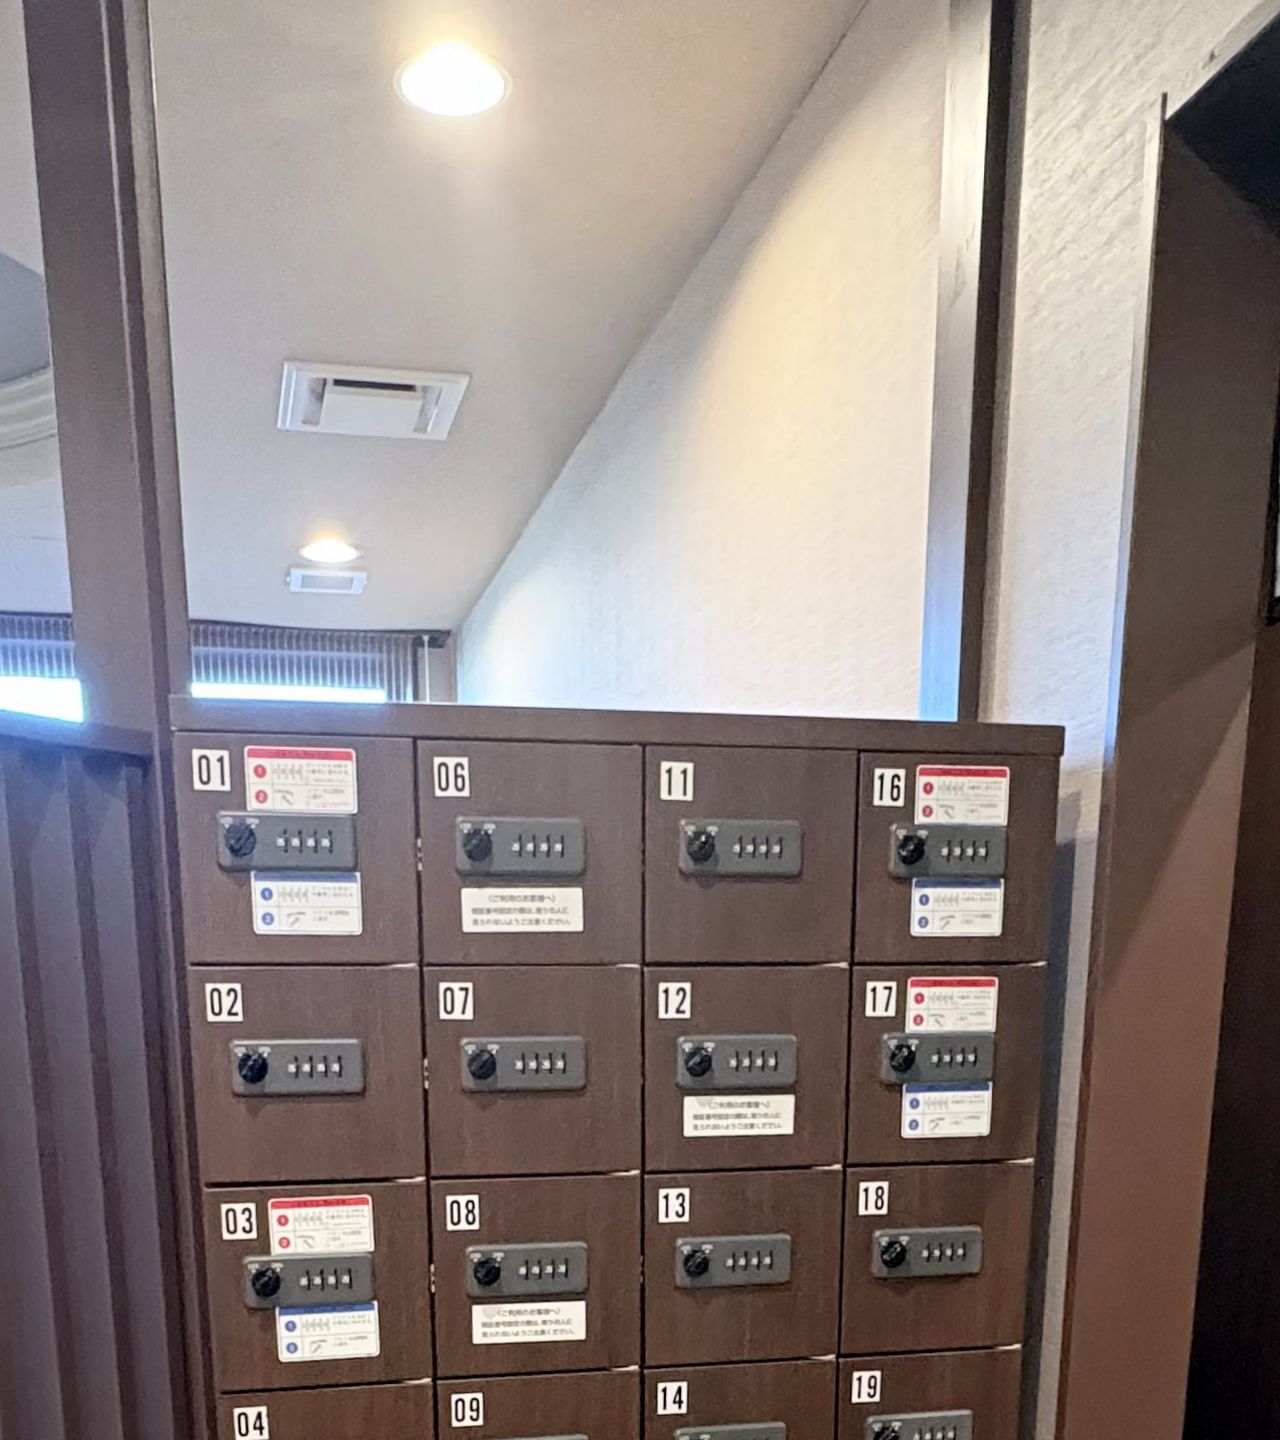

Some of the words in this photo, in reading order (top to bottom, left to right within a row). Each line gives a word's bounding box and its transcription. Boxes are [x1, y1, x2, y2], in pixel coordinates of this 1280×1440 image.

[198, 755, 224, 785] 01
[438, 763, 465, 791] 06
[666, 768, 687, 796] 11
[879, 773, 900, 801] 16
[210, 988, 238, 1016] 02
[444, 987, 468, 1014] 07
[663, 988, 686, 1014] 12
[871, 986, 892, 1012] 17
[663, 1193, 685, 1218] 13
[863, 1186, 884, 1212] 18
[226, 1208, 253, 1234] 03
[450, 1200, 475, 1226] 08
[662, 1386, 683, 1411] 14
[857, 1375, 877, 1398] 19
[455, 1398, 479, 1422] 09
[238, 1412, 264, 1437] 04
